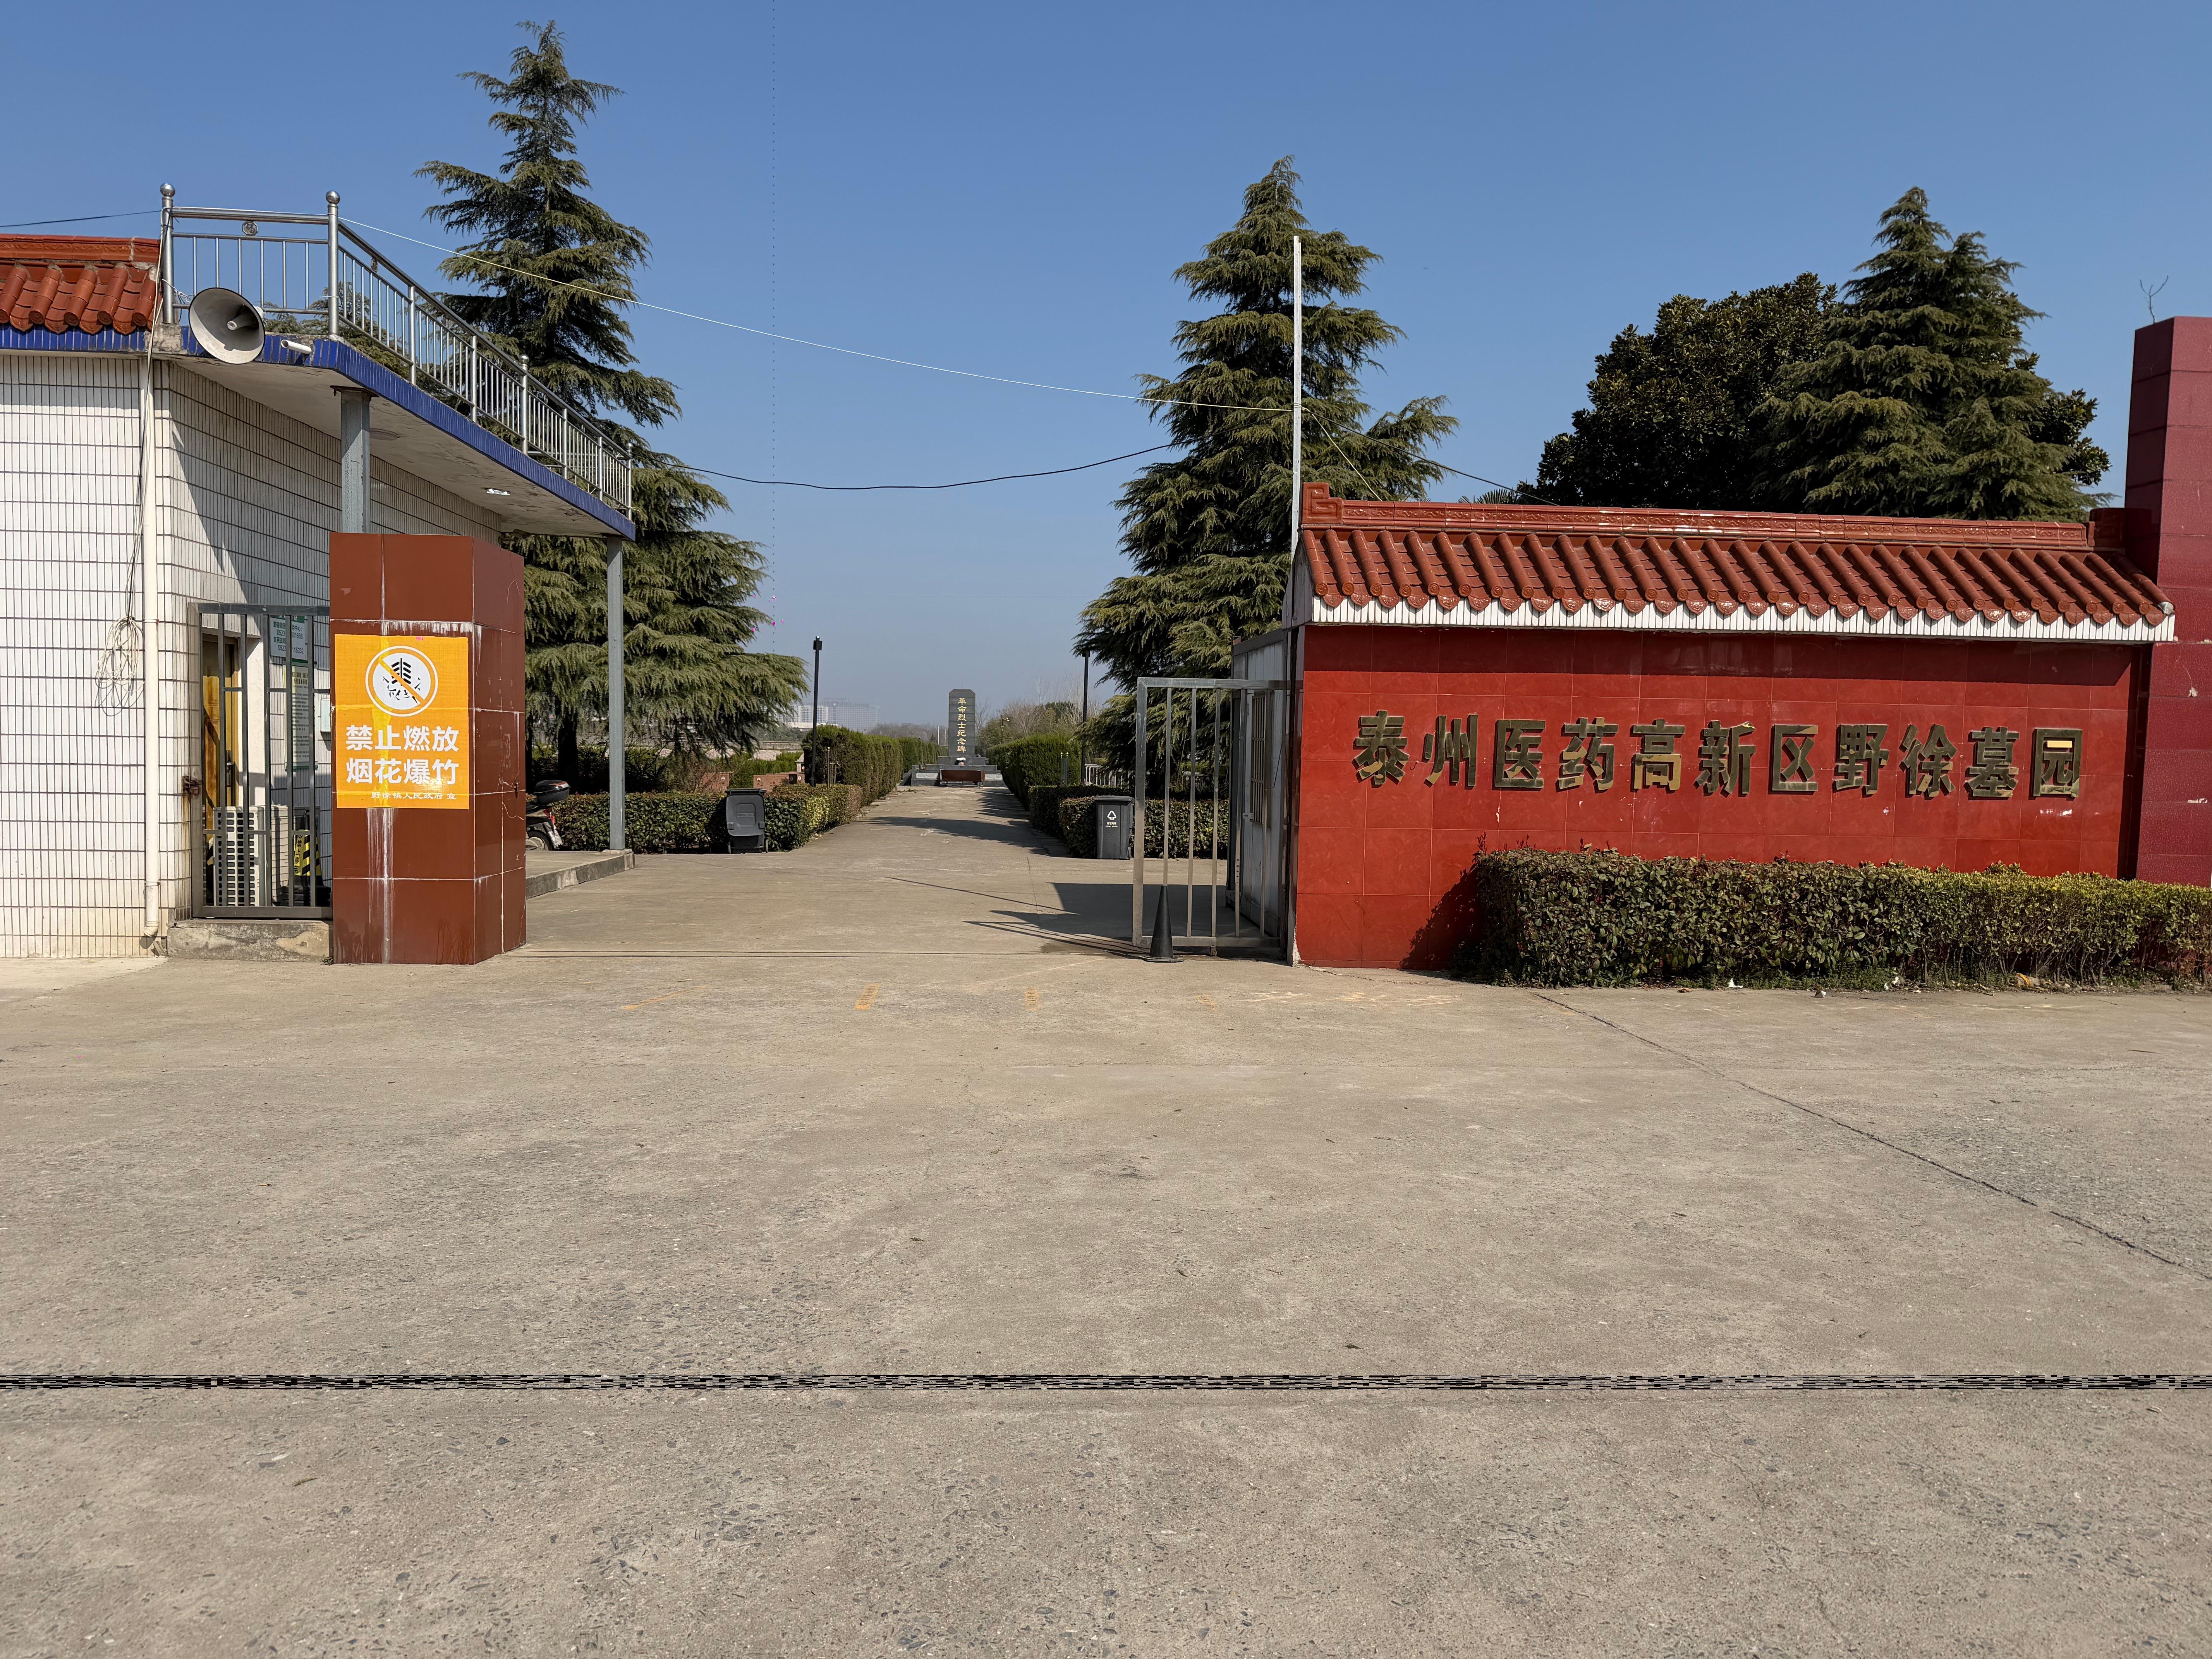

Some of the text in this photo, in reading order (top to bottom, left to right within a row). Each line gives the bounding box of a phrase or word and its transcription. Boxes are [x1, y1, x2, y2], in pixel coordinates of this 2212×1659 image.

[345, 725, 459, 752] 禁止燃放
[957, 697, 967, 753] 革命烈士纪念碑
[1351, 710, 2083, 799] 泰州医药高新区野徐墓园
[346, 757, 459, 785] 烟花爆竹
[371, 792, 444, 800] 野徐镇人民政府
